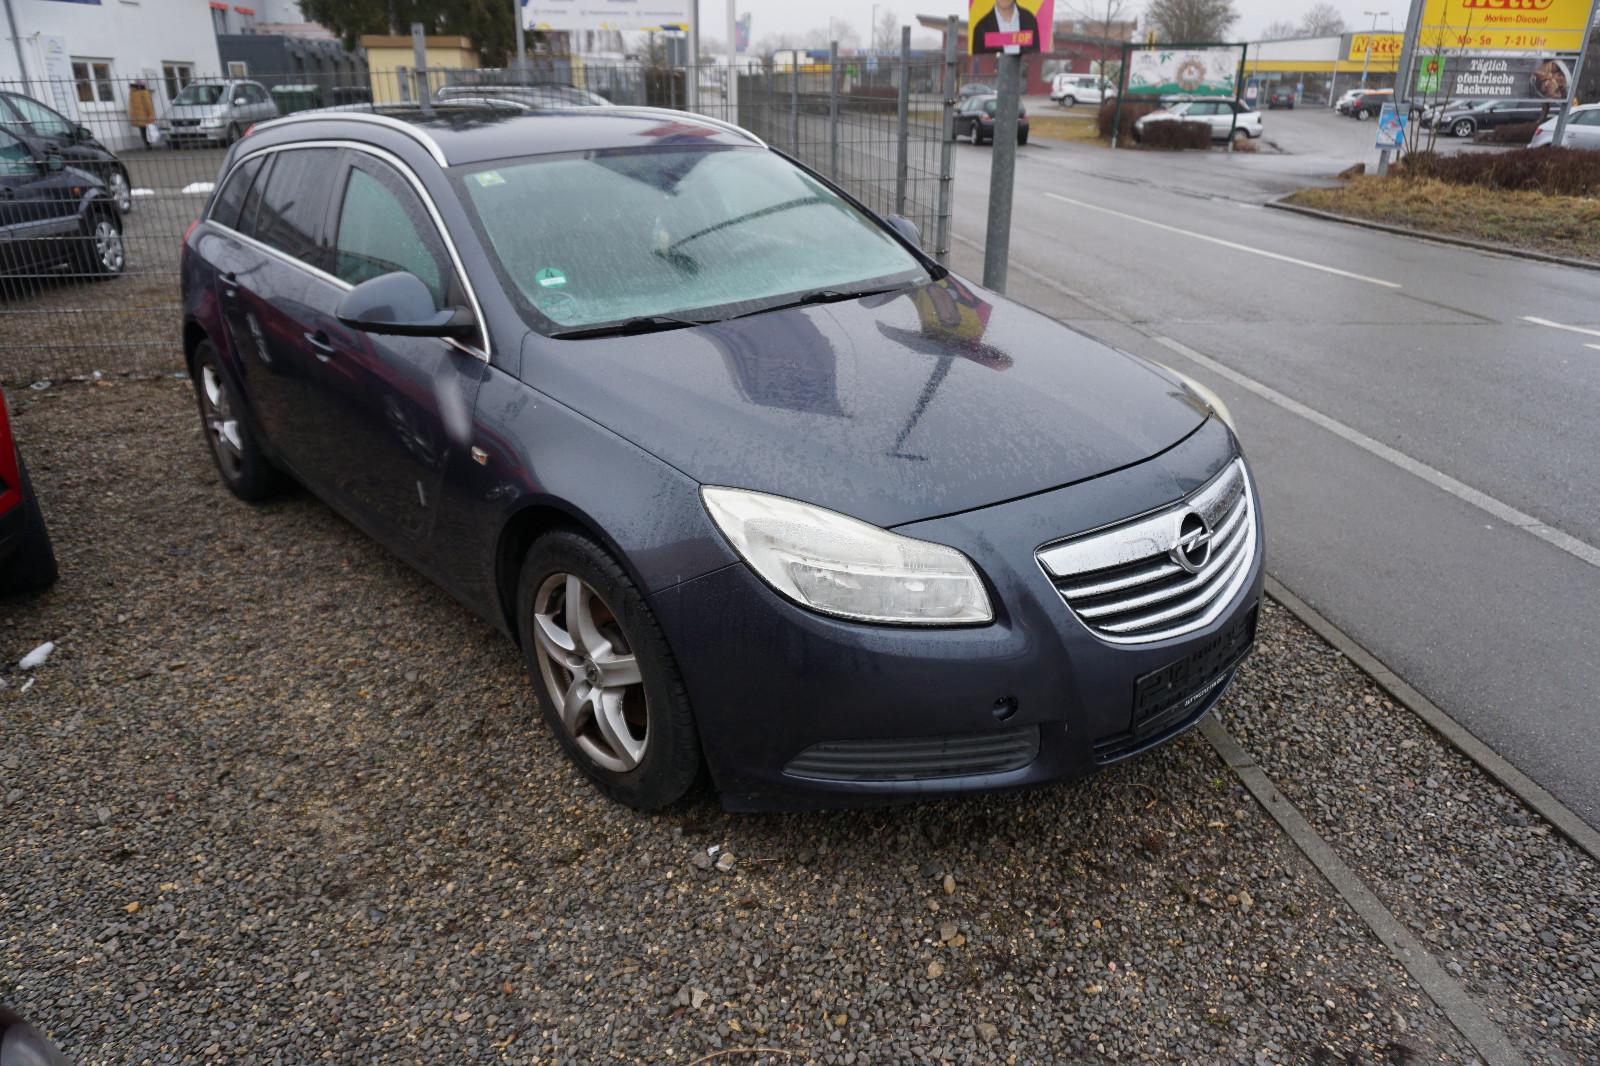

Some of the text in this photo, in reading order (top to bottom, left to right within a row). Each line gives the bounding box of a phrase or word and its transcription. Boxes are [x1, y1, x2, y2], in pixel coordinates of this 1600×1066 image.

[1480, 35, 1492, 45] Sa
[1530, 36, 1547, 46] Uhr
[1471, 60, 1508, 75] Täglich
[1457, 72, 1514, 84] ofenfrische
[1456, 84, 1511, 95] Backwaren
[544, 268, 554, 278] 4
